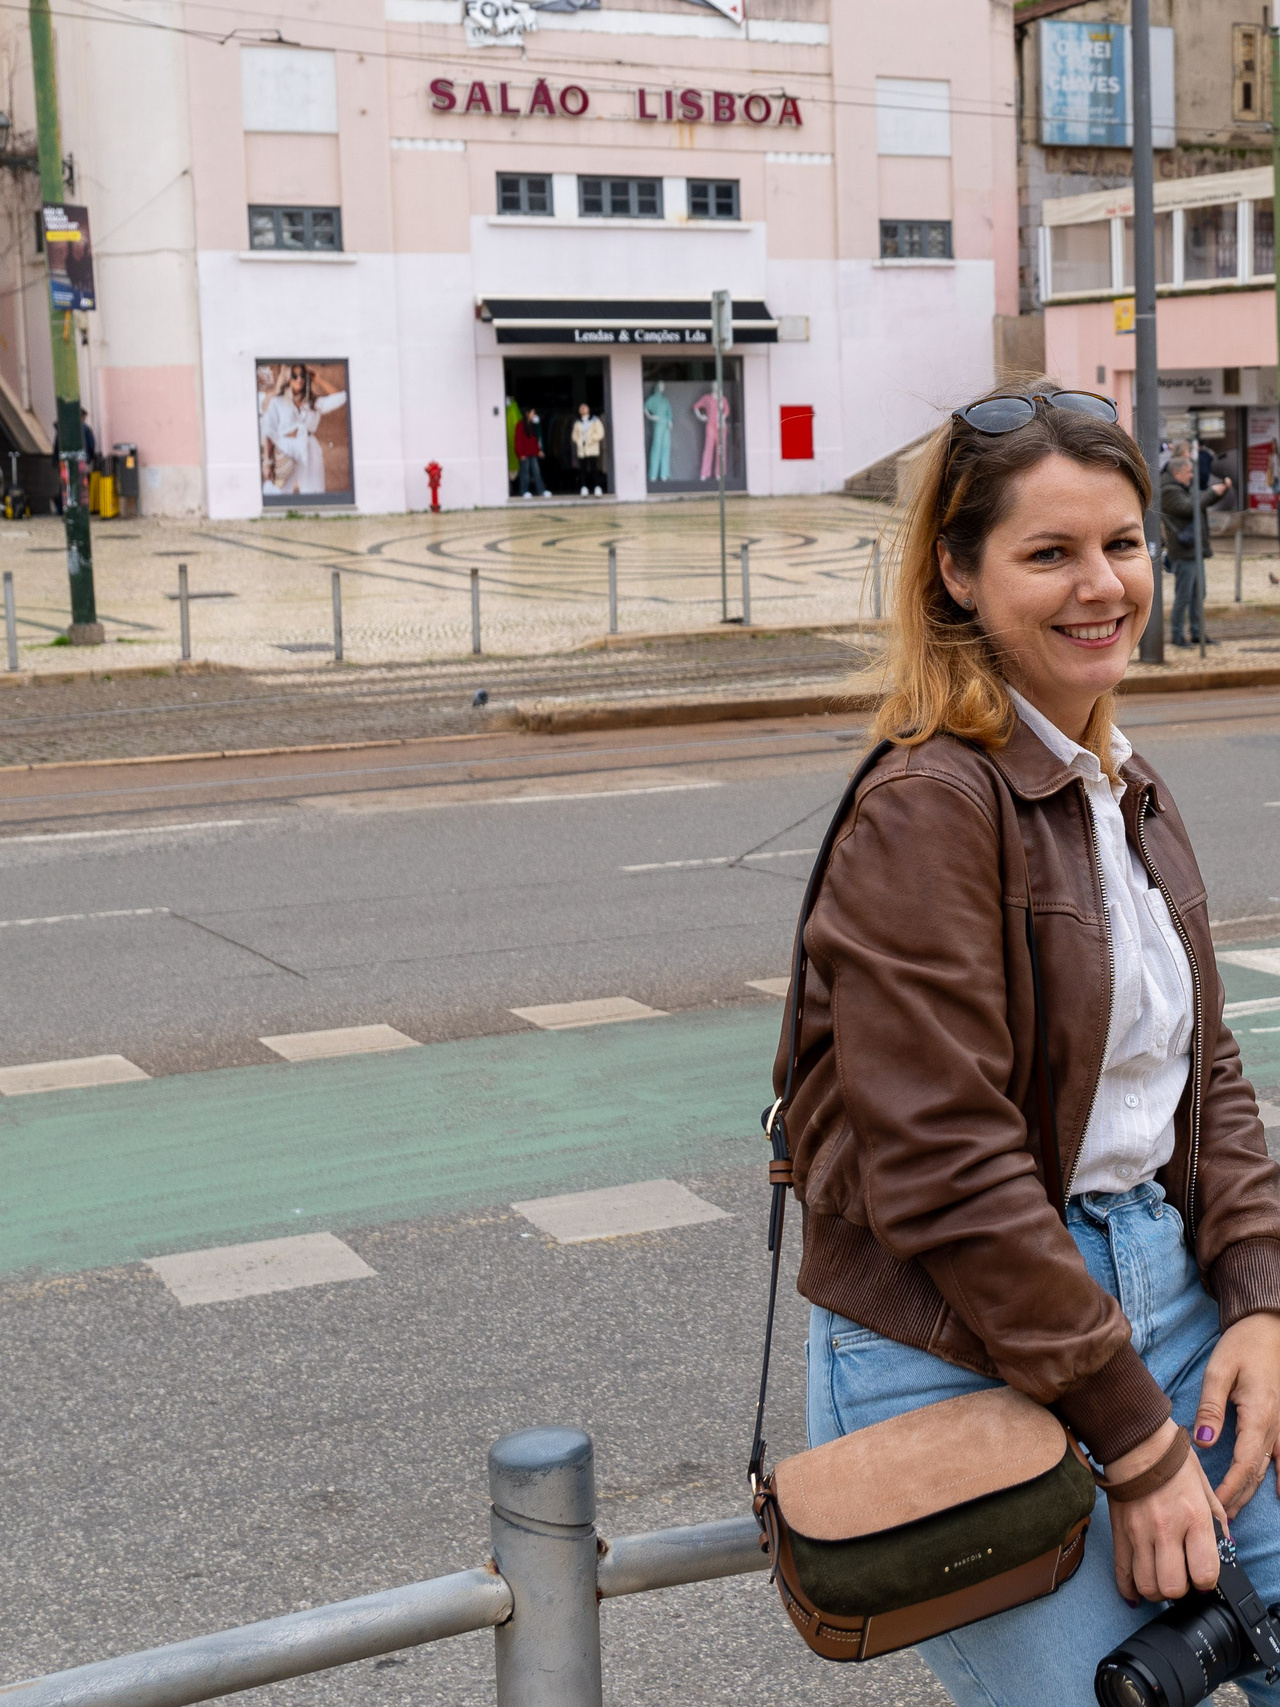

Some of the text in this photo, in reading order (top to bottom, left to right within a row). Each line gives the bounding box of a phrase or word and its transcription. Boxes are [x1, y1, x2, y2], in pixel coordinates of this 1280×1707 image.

[429, 77, 803, 126] SALÃO LISBOA
[574, 328, 707, 344] Lendas & Canções Lda
